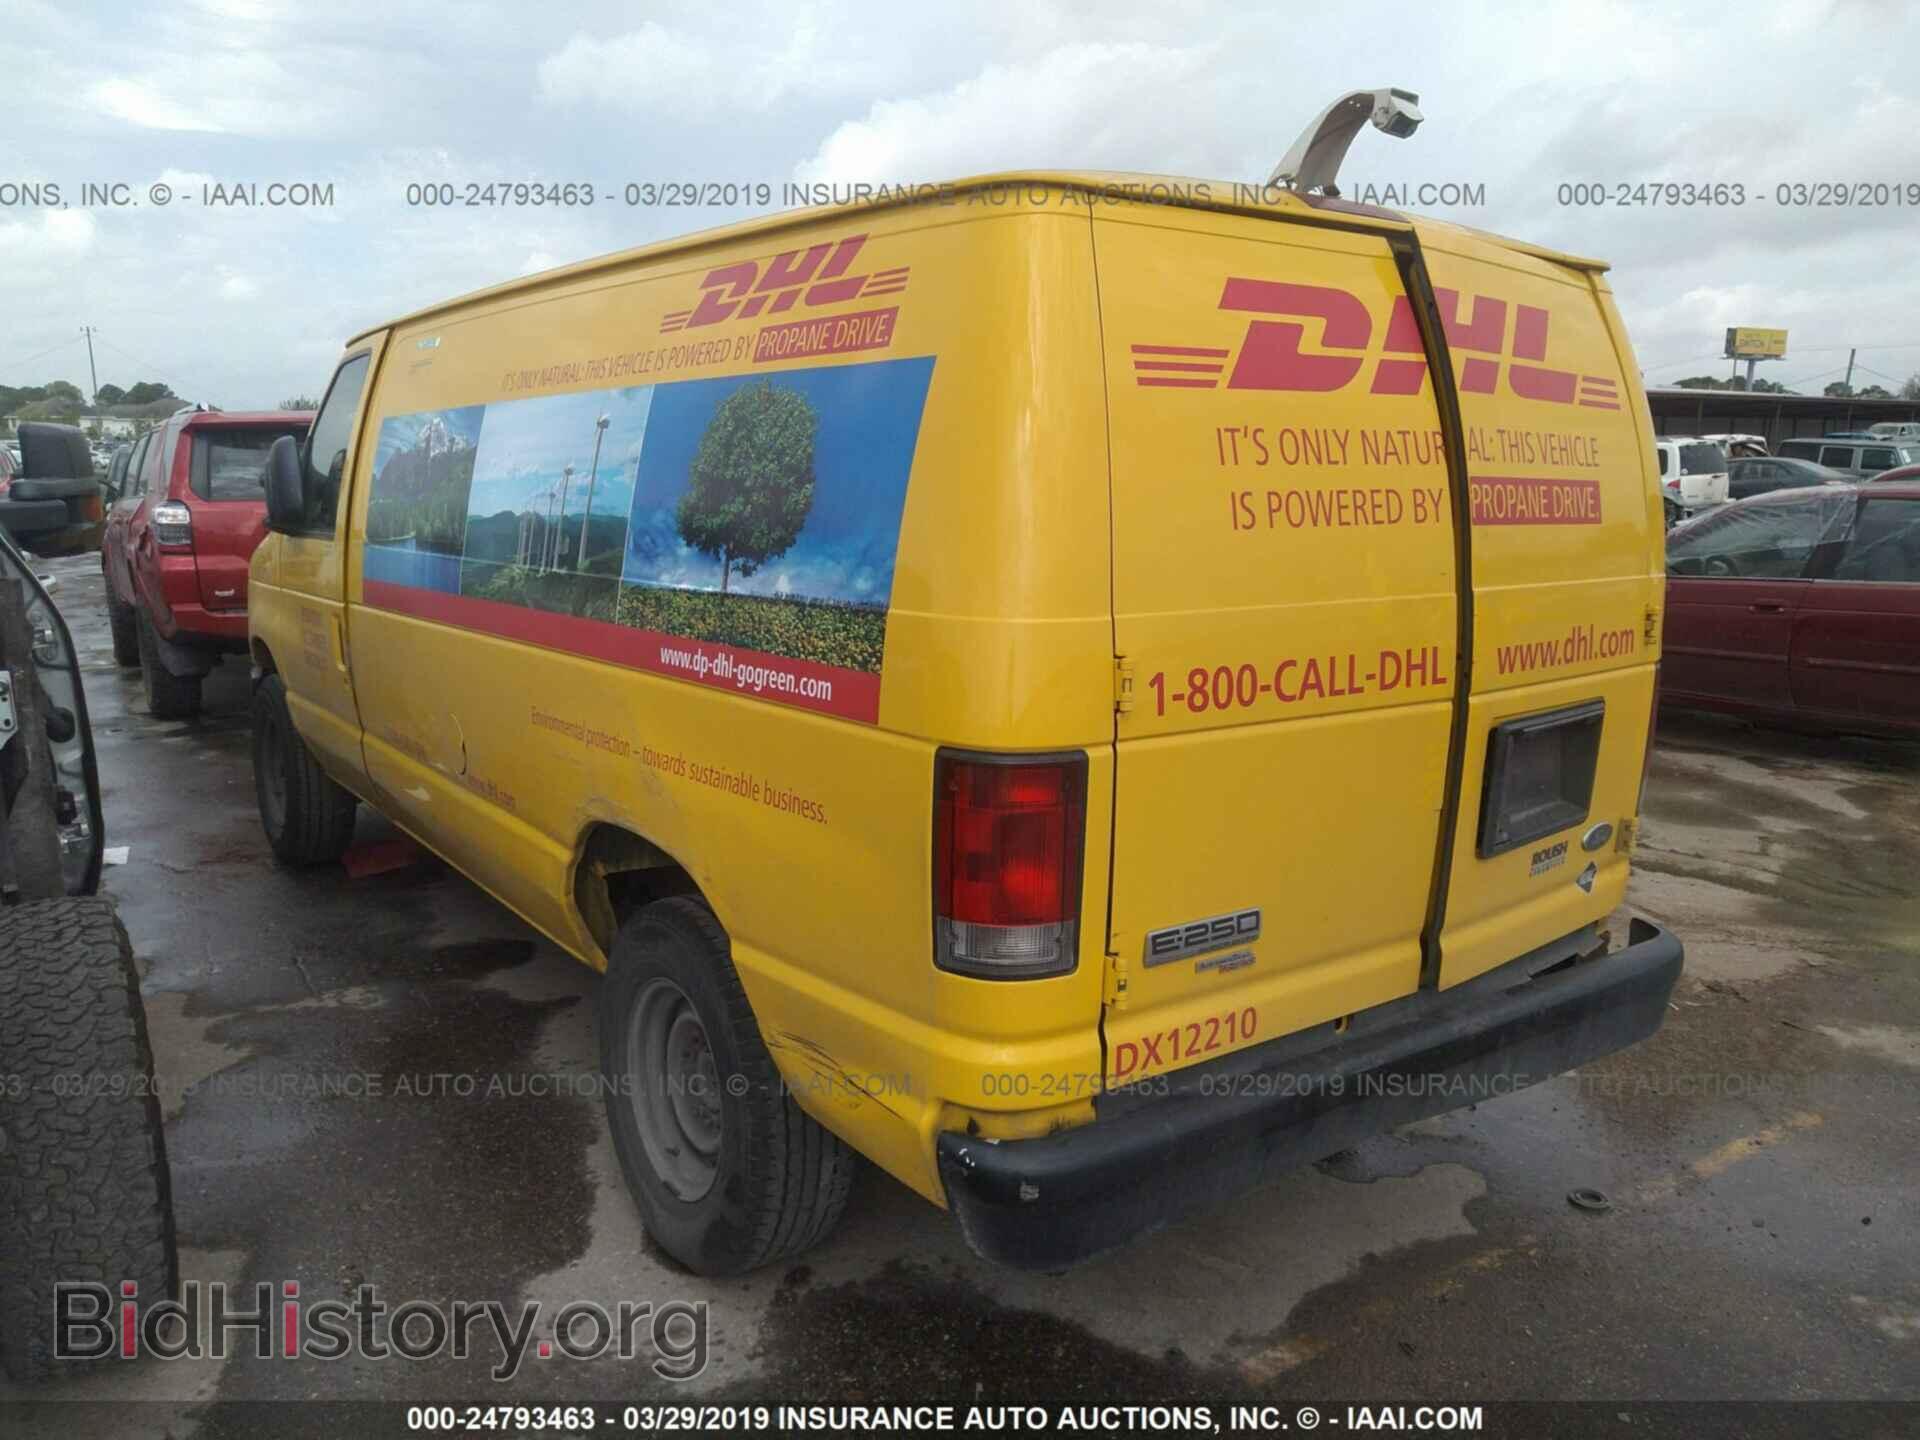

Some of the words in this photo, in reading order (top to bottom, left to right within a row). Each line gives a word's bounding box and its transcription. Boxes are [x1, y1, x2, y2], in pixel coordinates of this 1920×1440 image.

[685, 233, 870, 329] DHL
[609, 350, 652, 379] VEHICLE
[653, 348, 667, 373] IS
[667, 336, 731, 370] POWERED
[733, 333, 755, 362] BY
[756, 321, 832, 359] PROPANE
[832, 313, 890, 348] DRIVE.
[1218, 276, 1578, 405] DHL
[1216, 425, 1268, 466] IT'S
[1279, 428, 1350, 466] ONLY
[1496, 429, 1536, 464] THIS
[1536, 431, 1600, 468] VEHICLE
[1230, 491, 1256, 531] IS
[1267, 488, 1403, 529] POWERED
[1412, 488, 1444, 524] BY
[1471, 483, 1549, 519] PROPANE
[660, 646, 832, 701] www.dp-dhl-gogreen.com
[1148, 645, 1448, 717] 1-800-CALL-DHL
[1497, 624, 1635, 675] www.dhl.com
[642, 745, 687, 778] towards
[688, 759, 760, 802] sustainable
[763, 781, 829, 825] business.
[1115, 1006, 1257, 1078] DX12210
